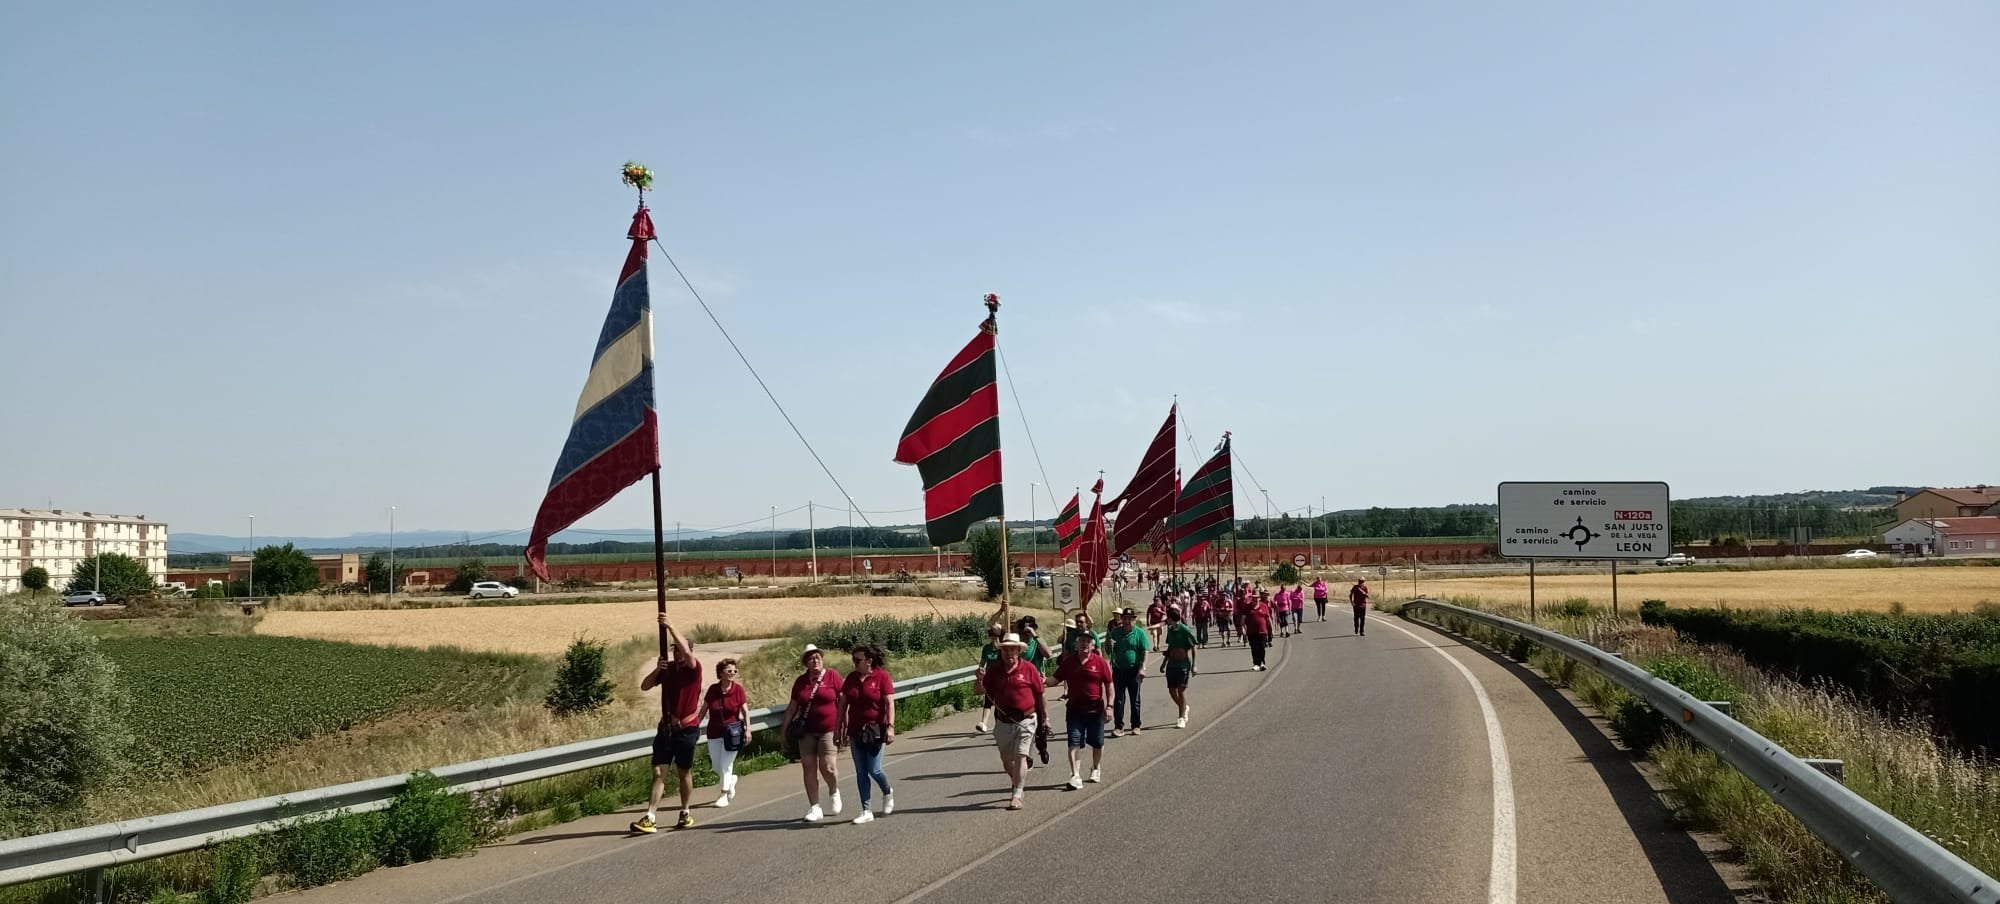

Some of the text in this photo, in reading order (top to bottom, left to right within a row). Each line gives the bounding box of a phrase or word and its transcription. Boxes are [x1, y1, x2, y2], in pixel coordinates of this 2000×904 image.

[1562, 488, 1597, 496] camino
[1553, 498, 1607, 506] de servicio
[1615, 512, 1652, 520] N-120a
[1616, 540, 1652, 552] LEÓN
